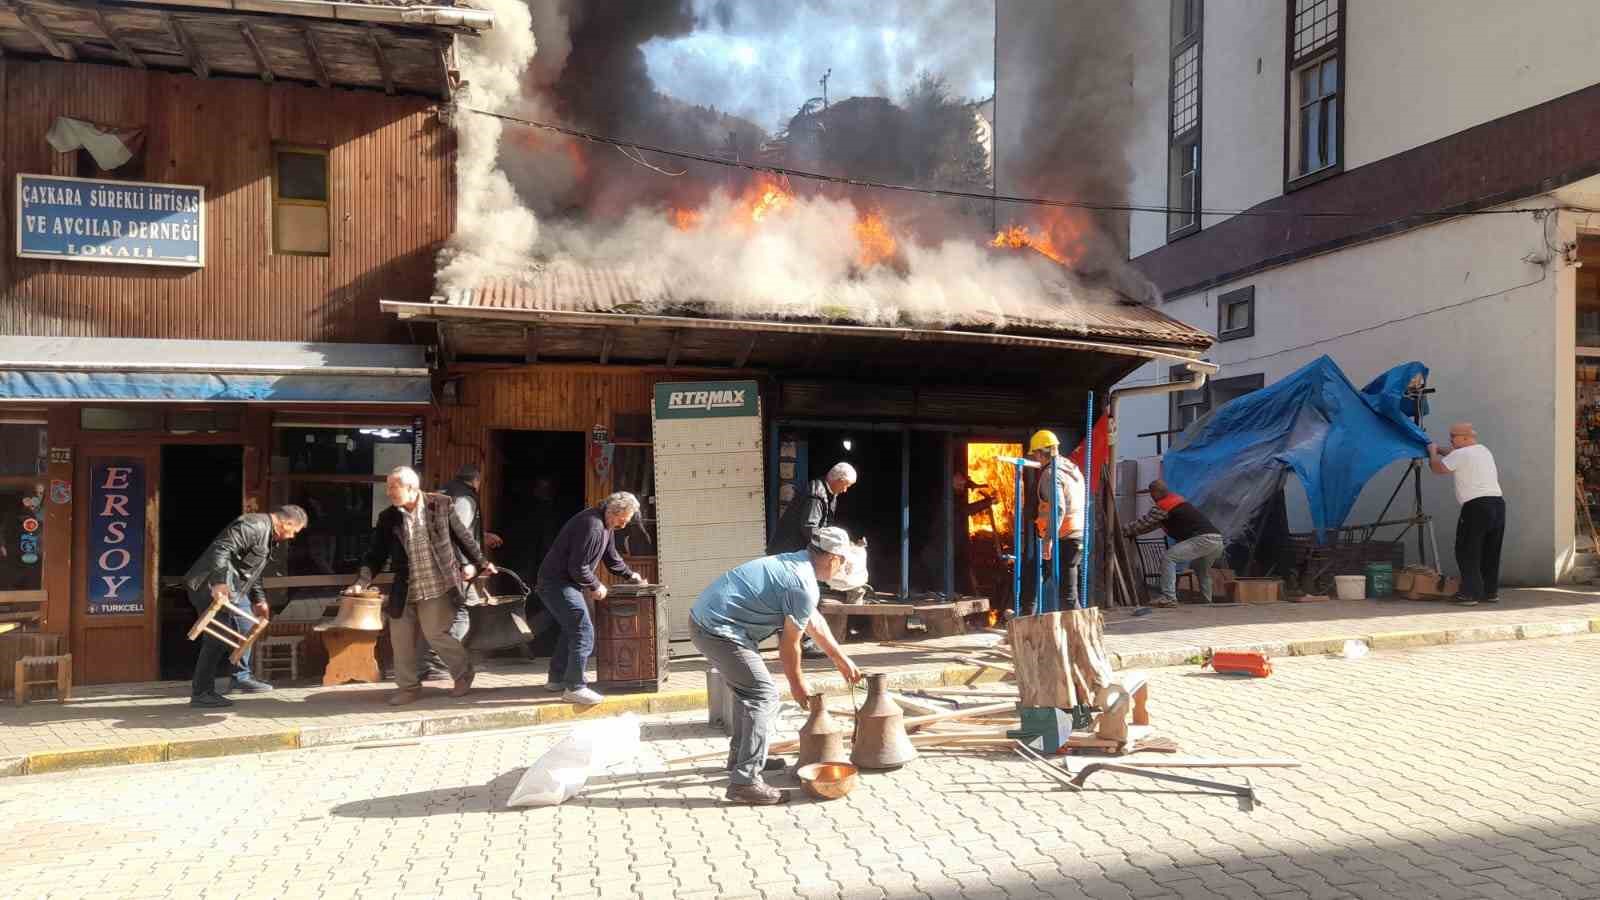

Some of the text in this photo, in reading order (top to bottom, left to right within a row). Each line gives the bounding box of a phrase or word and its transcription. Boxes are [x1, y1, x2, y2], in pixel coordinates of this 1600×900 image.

[22, 185, 198, 213] ÇAYKARA SÜREKLİ İHTİSAS
[26, 215, 198, 241] VE AVCILAR DERNEĞİ
[67, 244, 153, 258] LOKALİ
[668, 389, 745, 411] RTRMAX
[99, 467, 132, 598] ERSOY
[101, 604, 144, 613] TURKCELL
